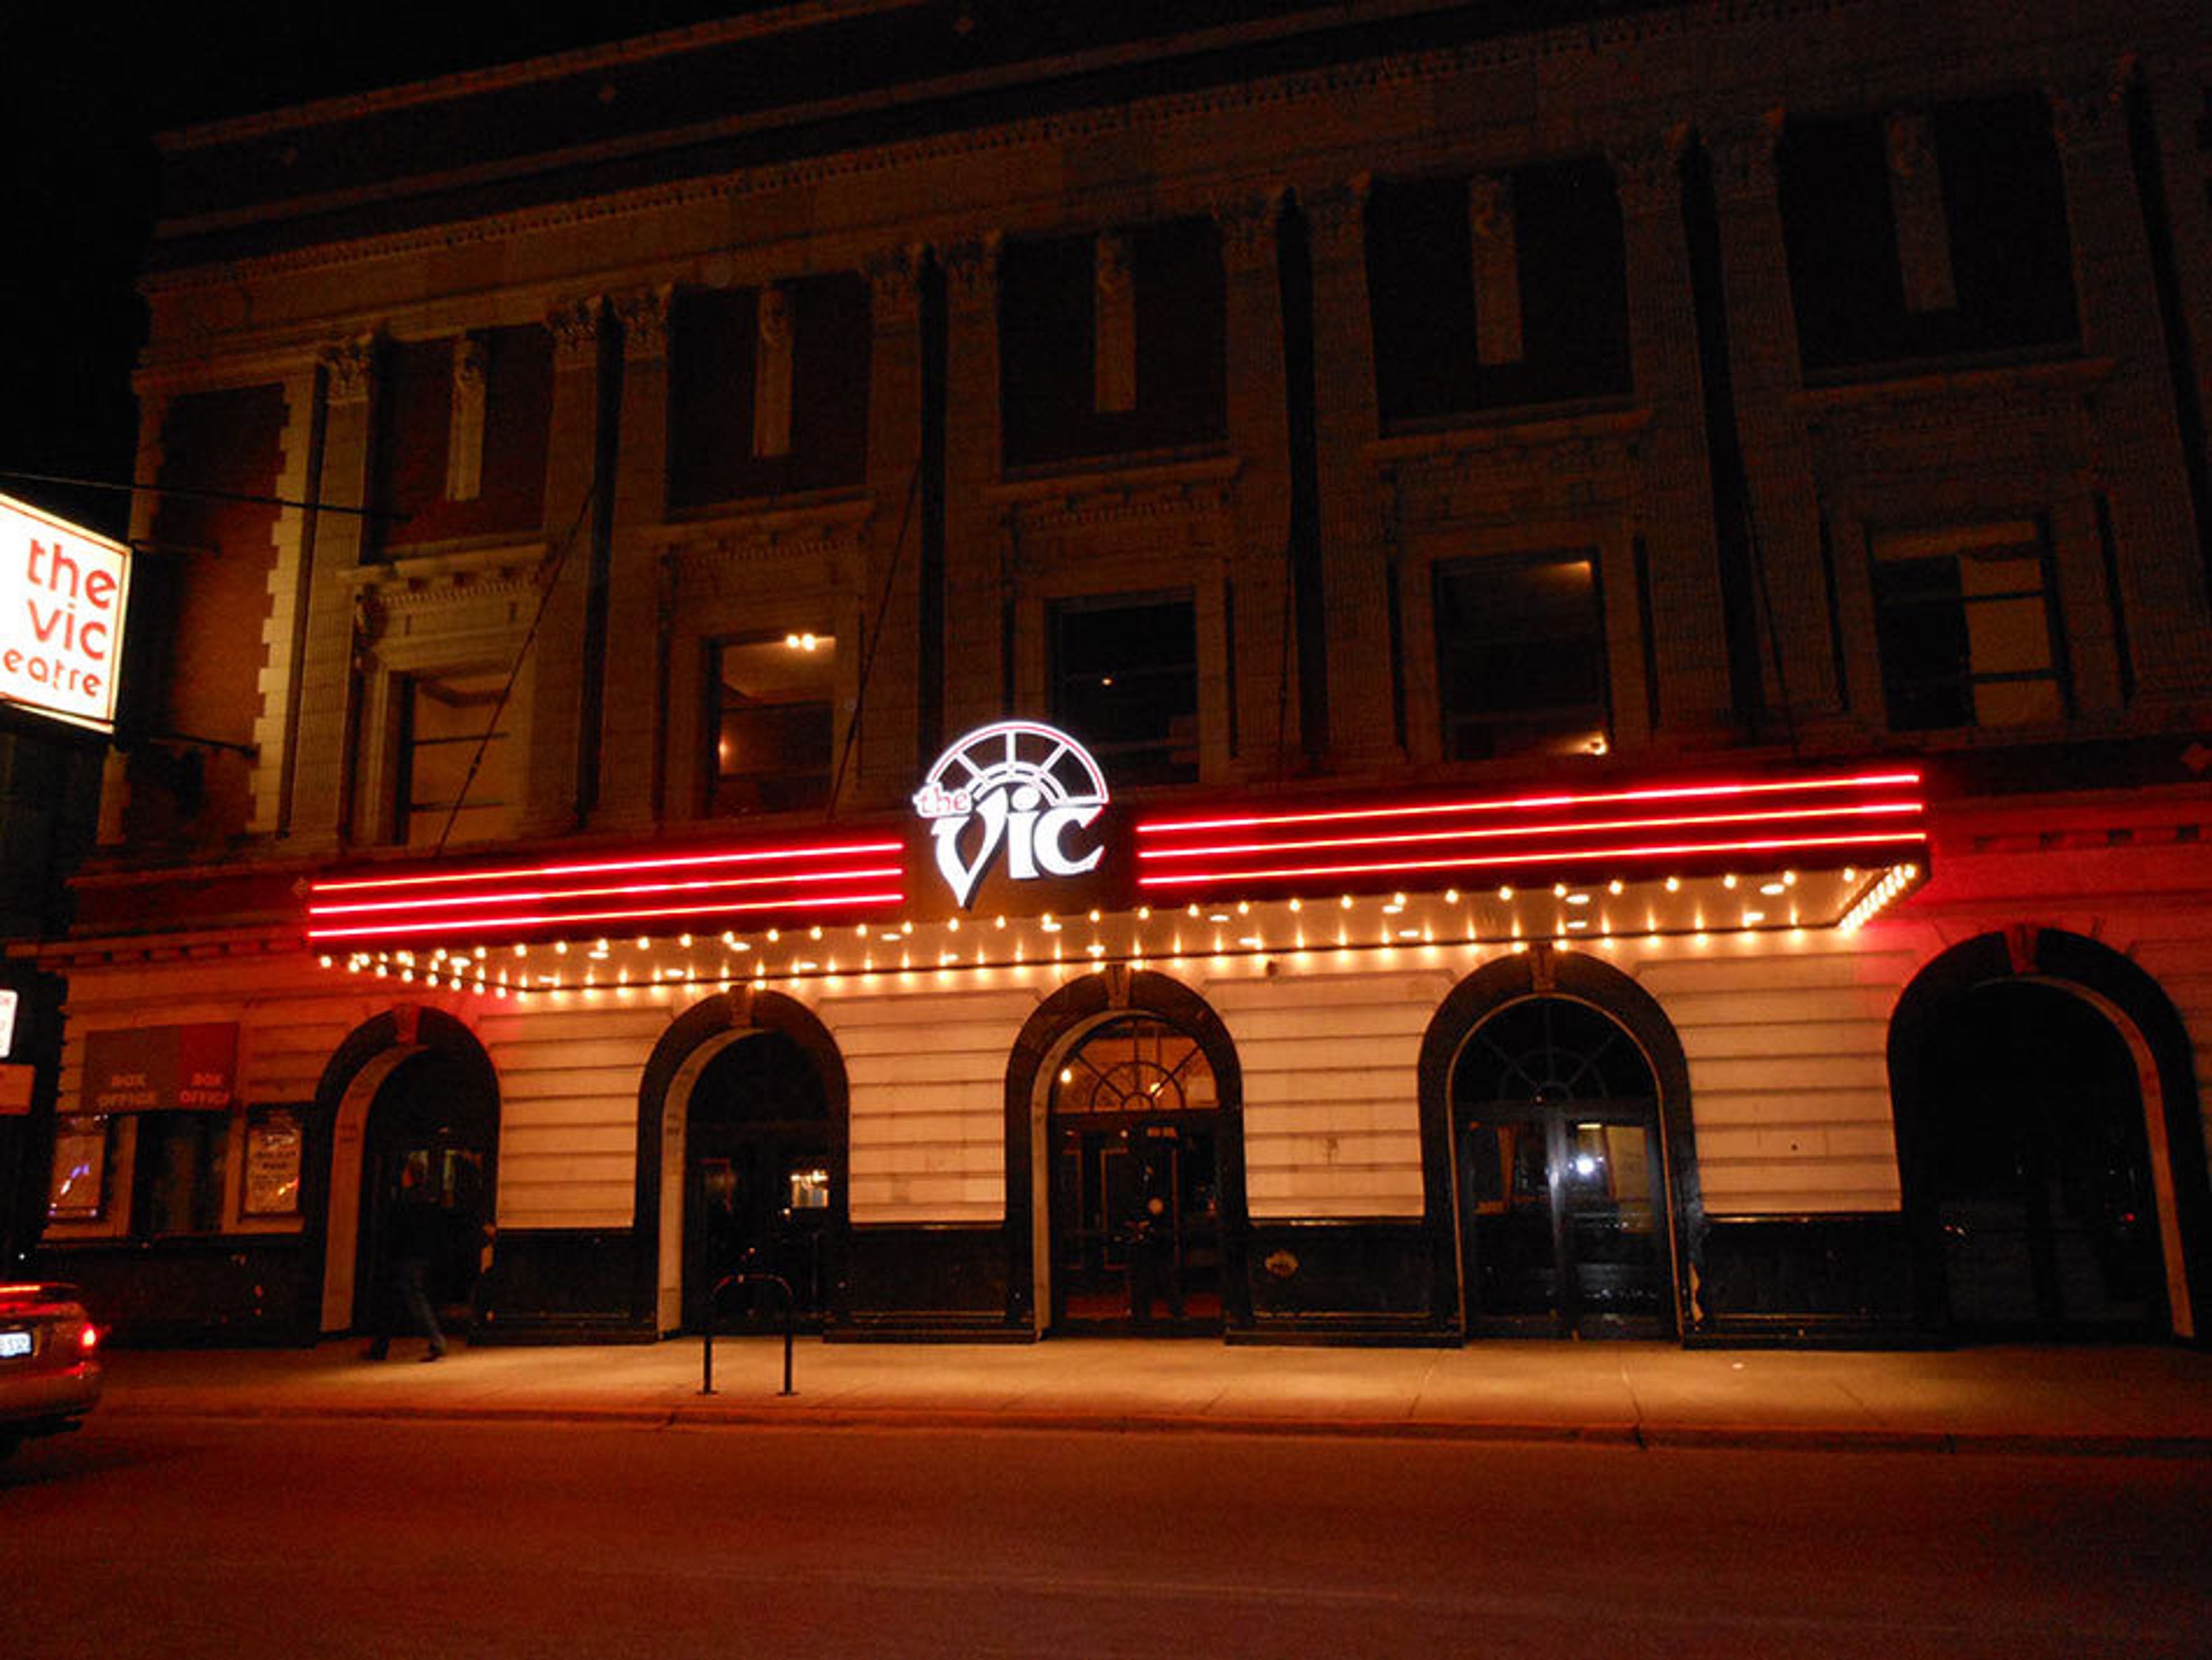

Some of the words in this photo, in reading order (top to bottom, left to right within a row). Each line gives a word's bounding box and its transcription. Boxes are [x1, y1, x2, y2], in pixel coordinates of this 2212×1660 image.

[27, 539, 117, 609] the
[27, 598, 108, 660] vic
[917, 782, 972, 817] the
